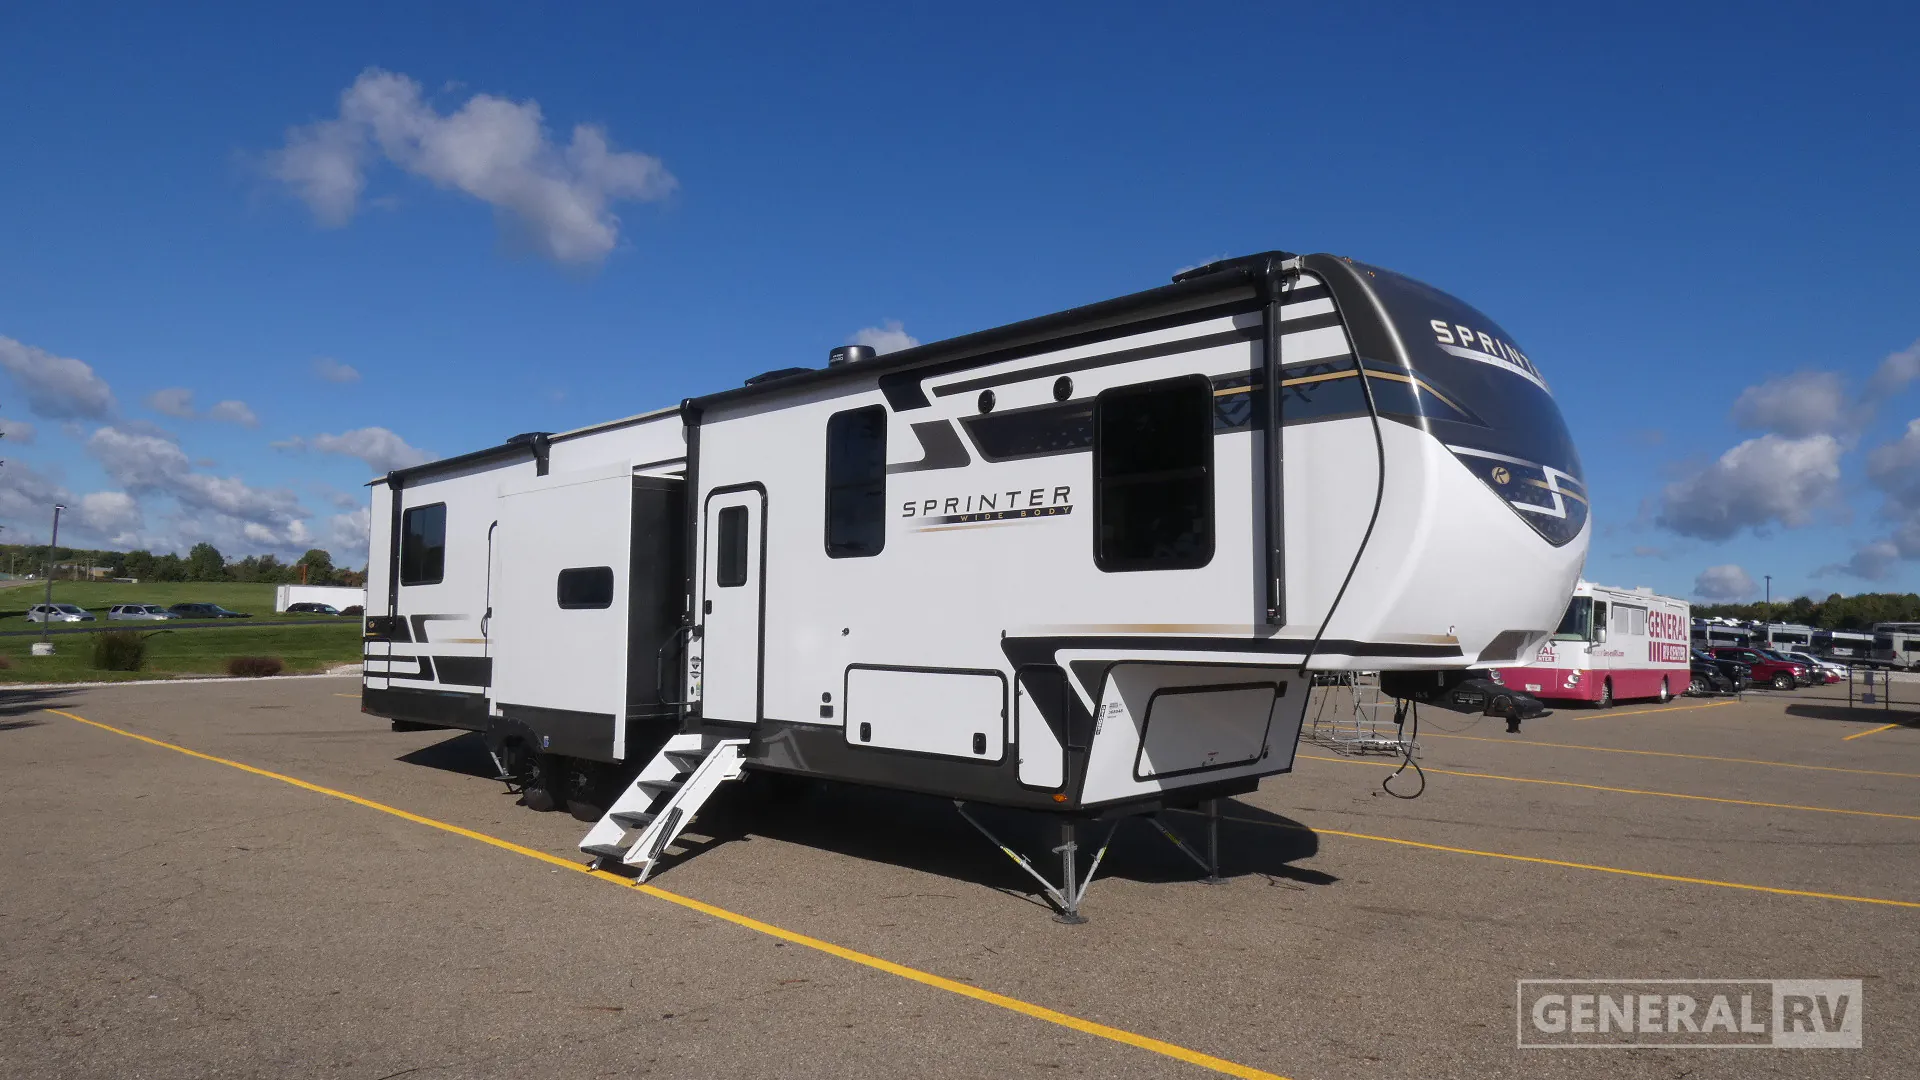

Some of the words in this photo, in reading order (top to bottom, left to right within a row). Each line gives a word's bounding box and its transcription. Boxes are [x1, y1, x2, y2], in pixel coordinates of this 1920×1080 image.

[902, 485, 1071, 518] SPRINTER
[960, 513, 1004, 522] WIDE
[1020, 506, 1070, 517] BODY
[1648, 610, 1687, 641] GENERAL
